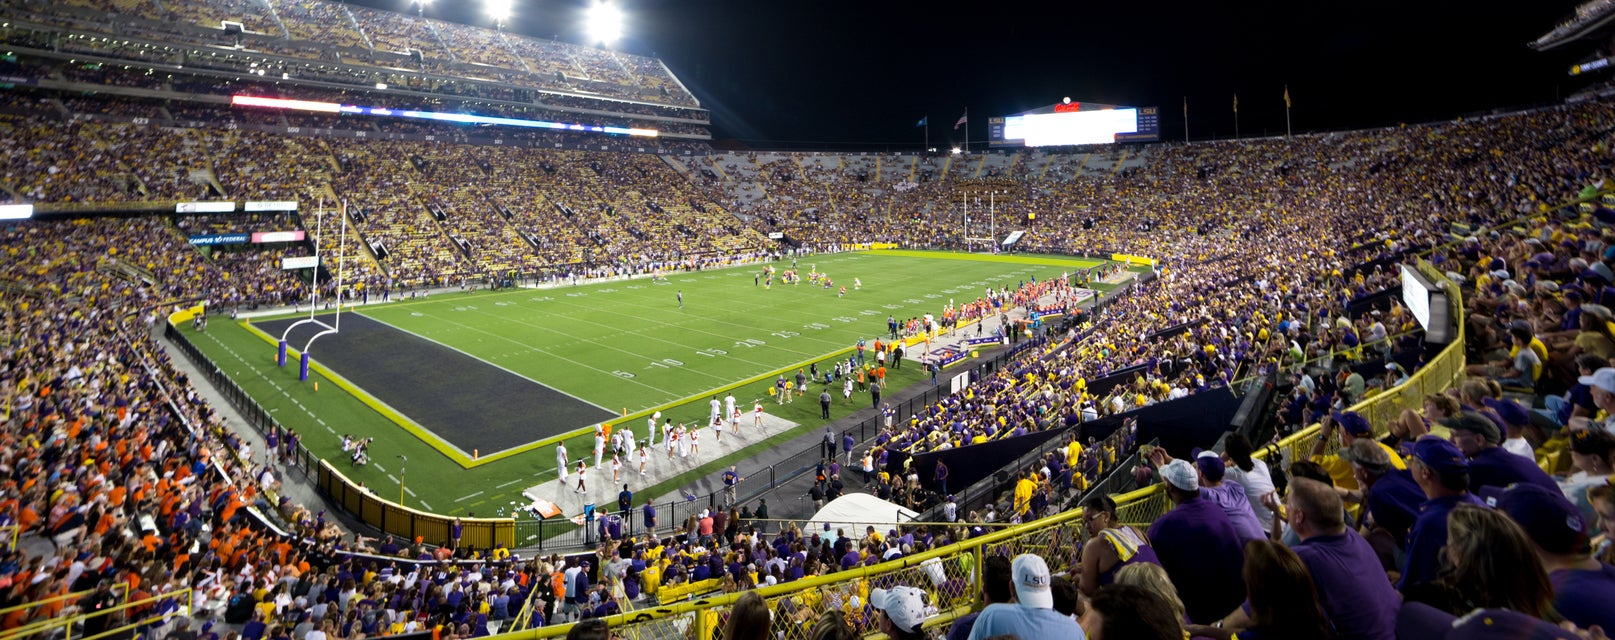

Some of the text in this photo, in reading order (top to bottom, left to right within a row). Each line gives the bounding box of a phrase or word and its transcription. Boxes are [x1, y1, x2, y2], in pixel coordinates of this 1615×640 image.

[735, 339, 767, 348] 20
[695, 348, 728, 357] 15
[650, 358, 685, 369] 10
[612, 370, 636, 378] 5
[1024, 574, 1047, 585] LSU
